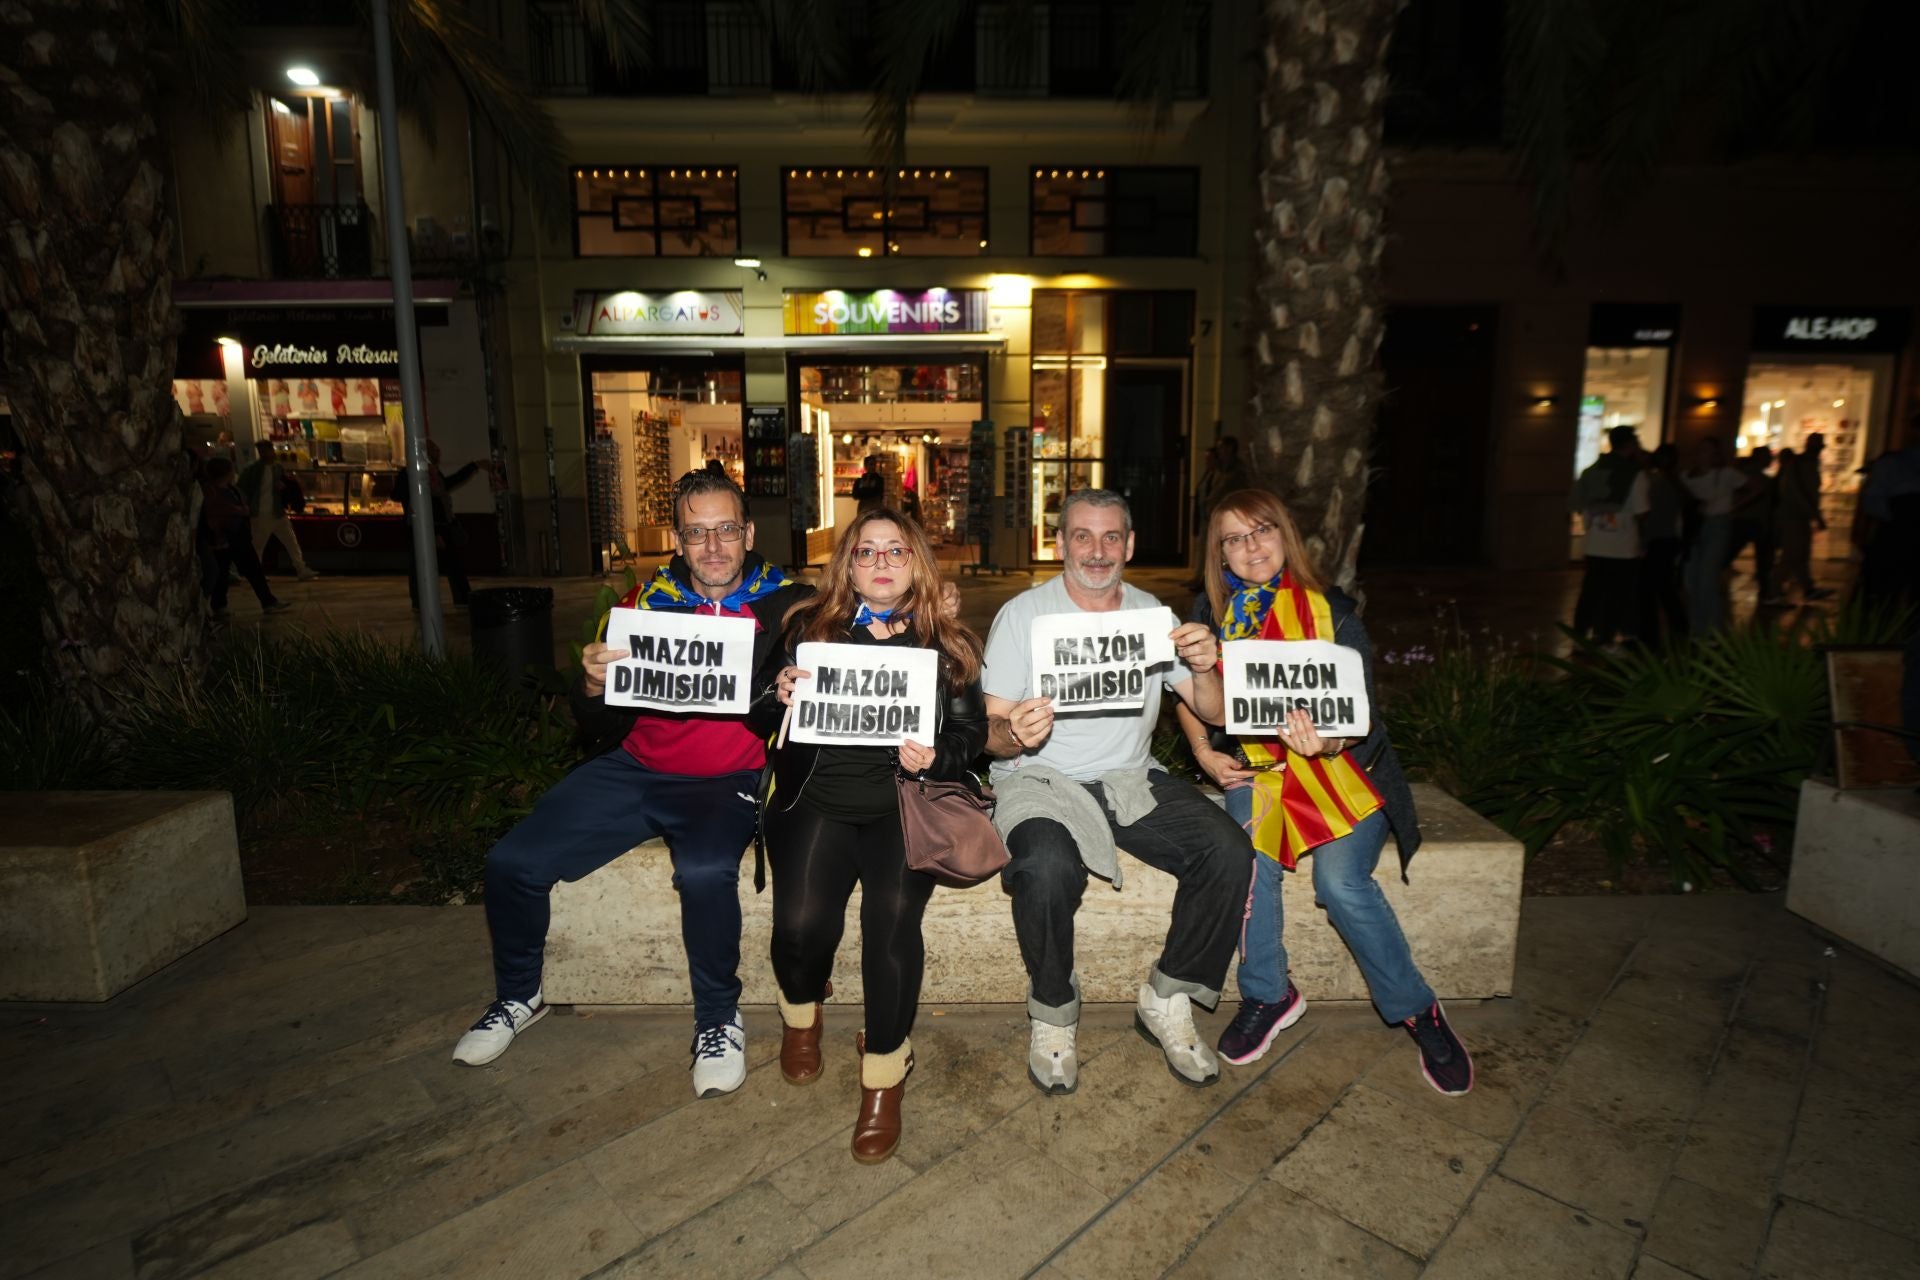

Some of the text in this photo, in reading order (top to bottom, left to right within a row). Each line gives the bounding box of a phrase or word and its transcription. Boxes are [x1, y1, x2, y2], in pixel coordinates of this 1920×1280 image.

[814, 301, 961, 324] SOUVENIRS
[1200, 319, 1212, 337] 7
[1784, 315, 1878, 341] ALE-HOP
[251, 343, 328, 369] Gelateries
[629, 634, 724, 667] MAZÓN
[1054, 629, 1146, 666] MAZÓN
[613, 668, 737, 702] DIMISIÓN
[816, 664, 909, 698] MAZÓN
[1041, 663, 1143, 703] DIMISIÓ
[1245, 658, 1338, 690] MAZÓN
[798, 699, 921, 735] DIMISIÓN
